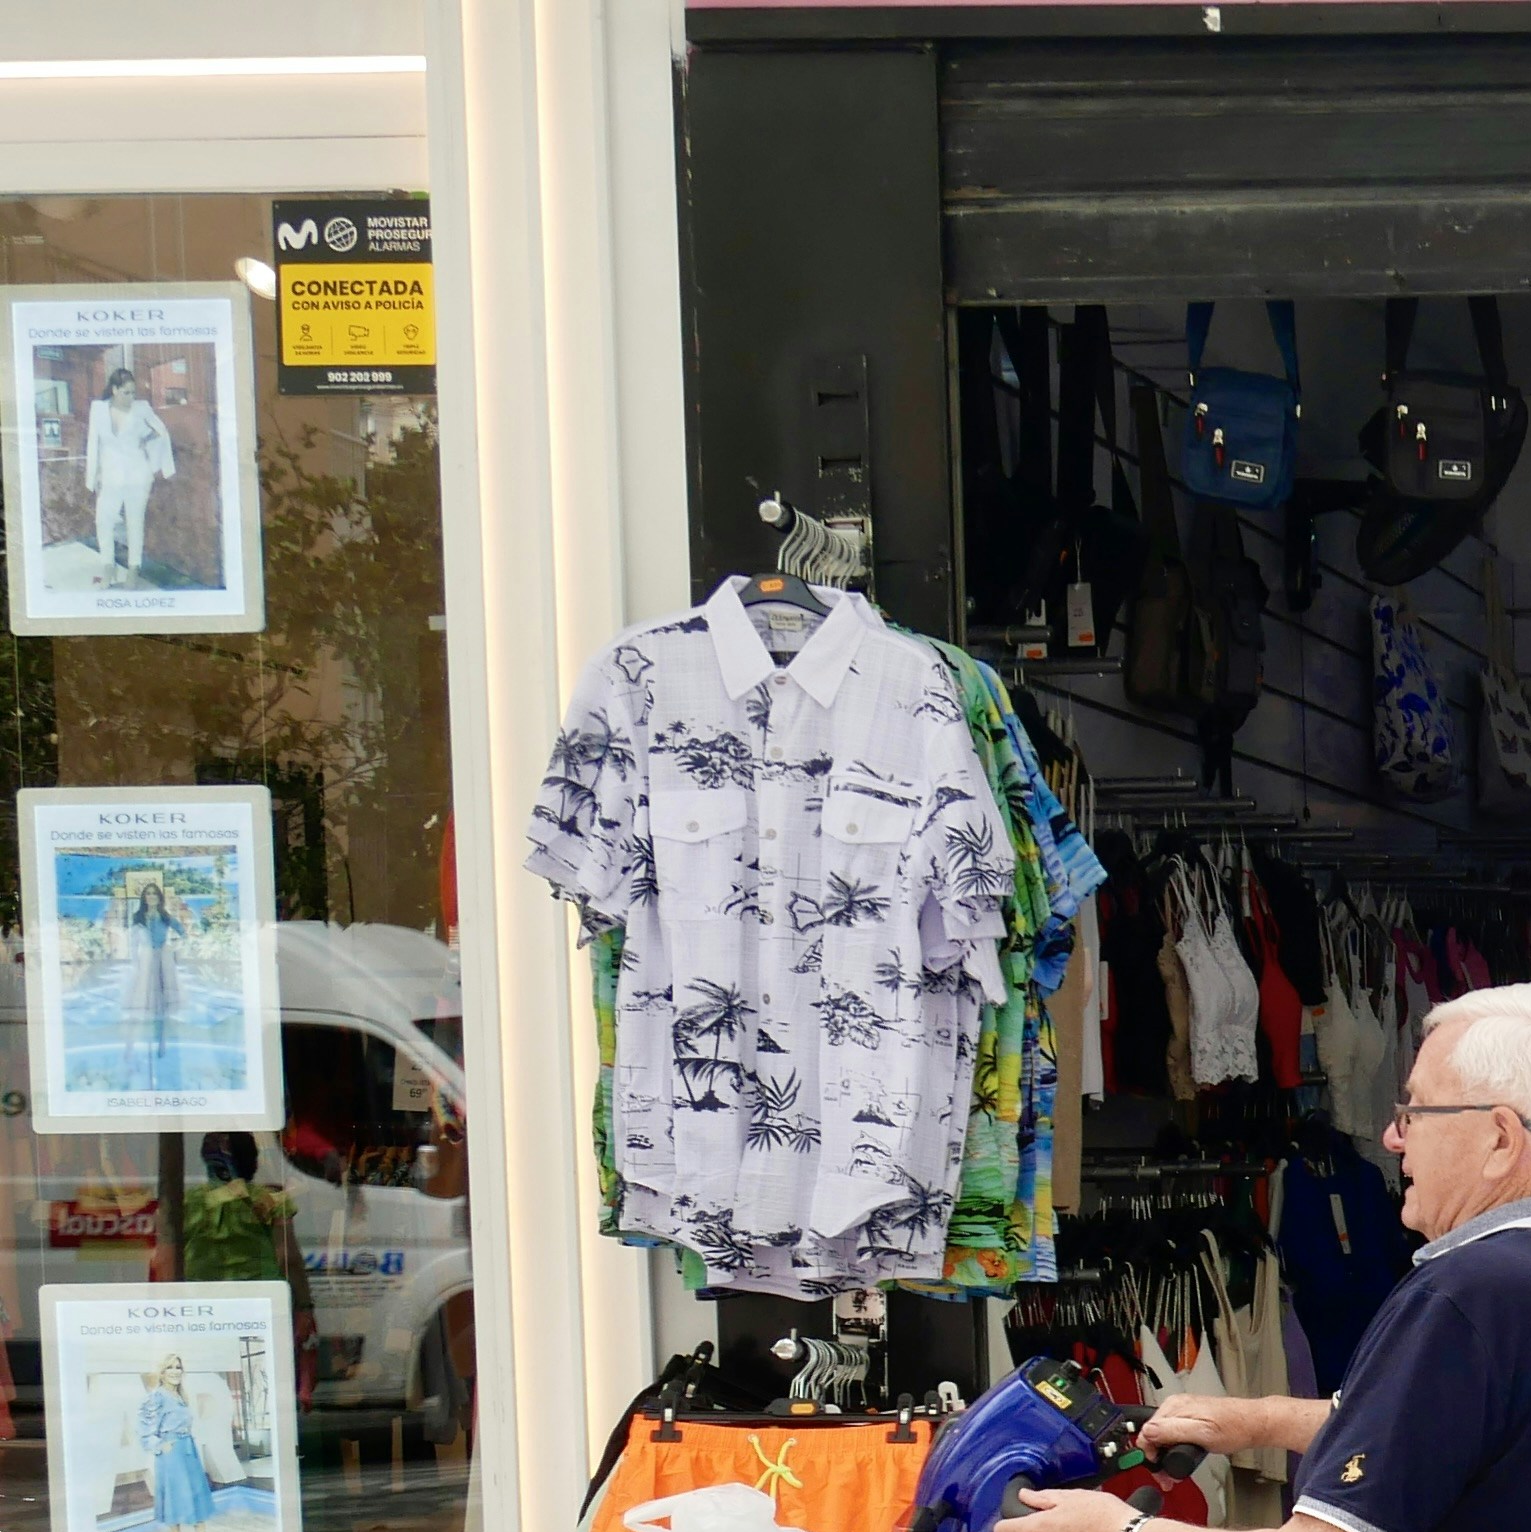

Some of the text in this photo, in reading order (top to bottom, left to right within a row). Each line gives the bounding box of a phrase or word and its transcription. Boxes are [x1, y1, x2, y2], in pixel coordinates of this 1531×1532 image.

[366, 216, 428, 229] MOVISTAR
[368, 228, 432, 241] PROSEGUR
[368, 241, 421, 252] ALARMAS
[291, 280, 424, 296] CONECTADA
[292, 298, 424, 311] CON AVISO A POLICÍA
[77, 308, 165, 322] KOKER
[29, 325, 218, 339] Donde se visten las famosas
[327, 371, 348, 383] 902
[96, 598, 132, 609] ROSA
[99, 811, 187, 825] KOKER
[50, 828, 239, 841] Donde se visten las famosas
[106, 1096, 151, 1108] ISABEL
[127, 1304, 214, 1318] KOKER
[80, 1320, 267, 1336] Donde se visten las famosas
